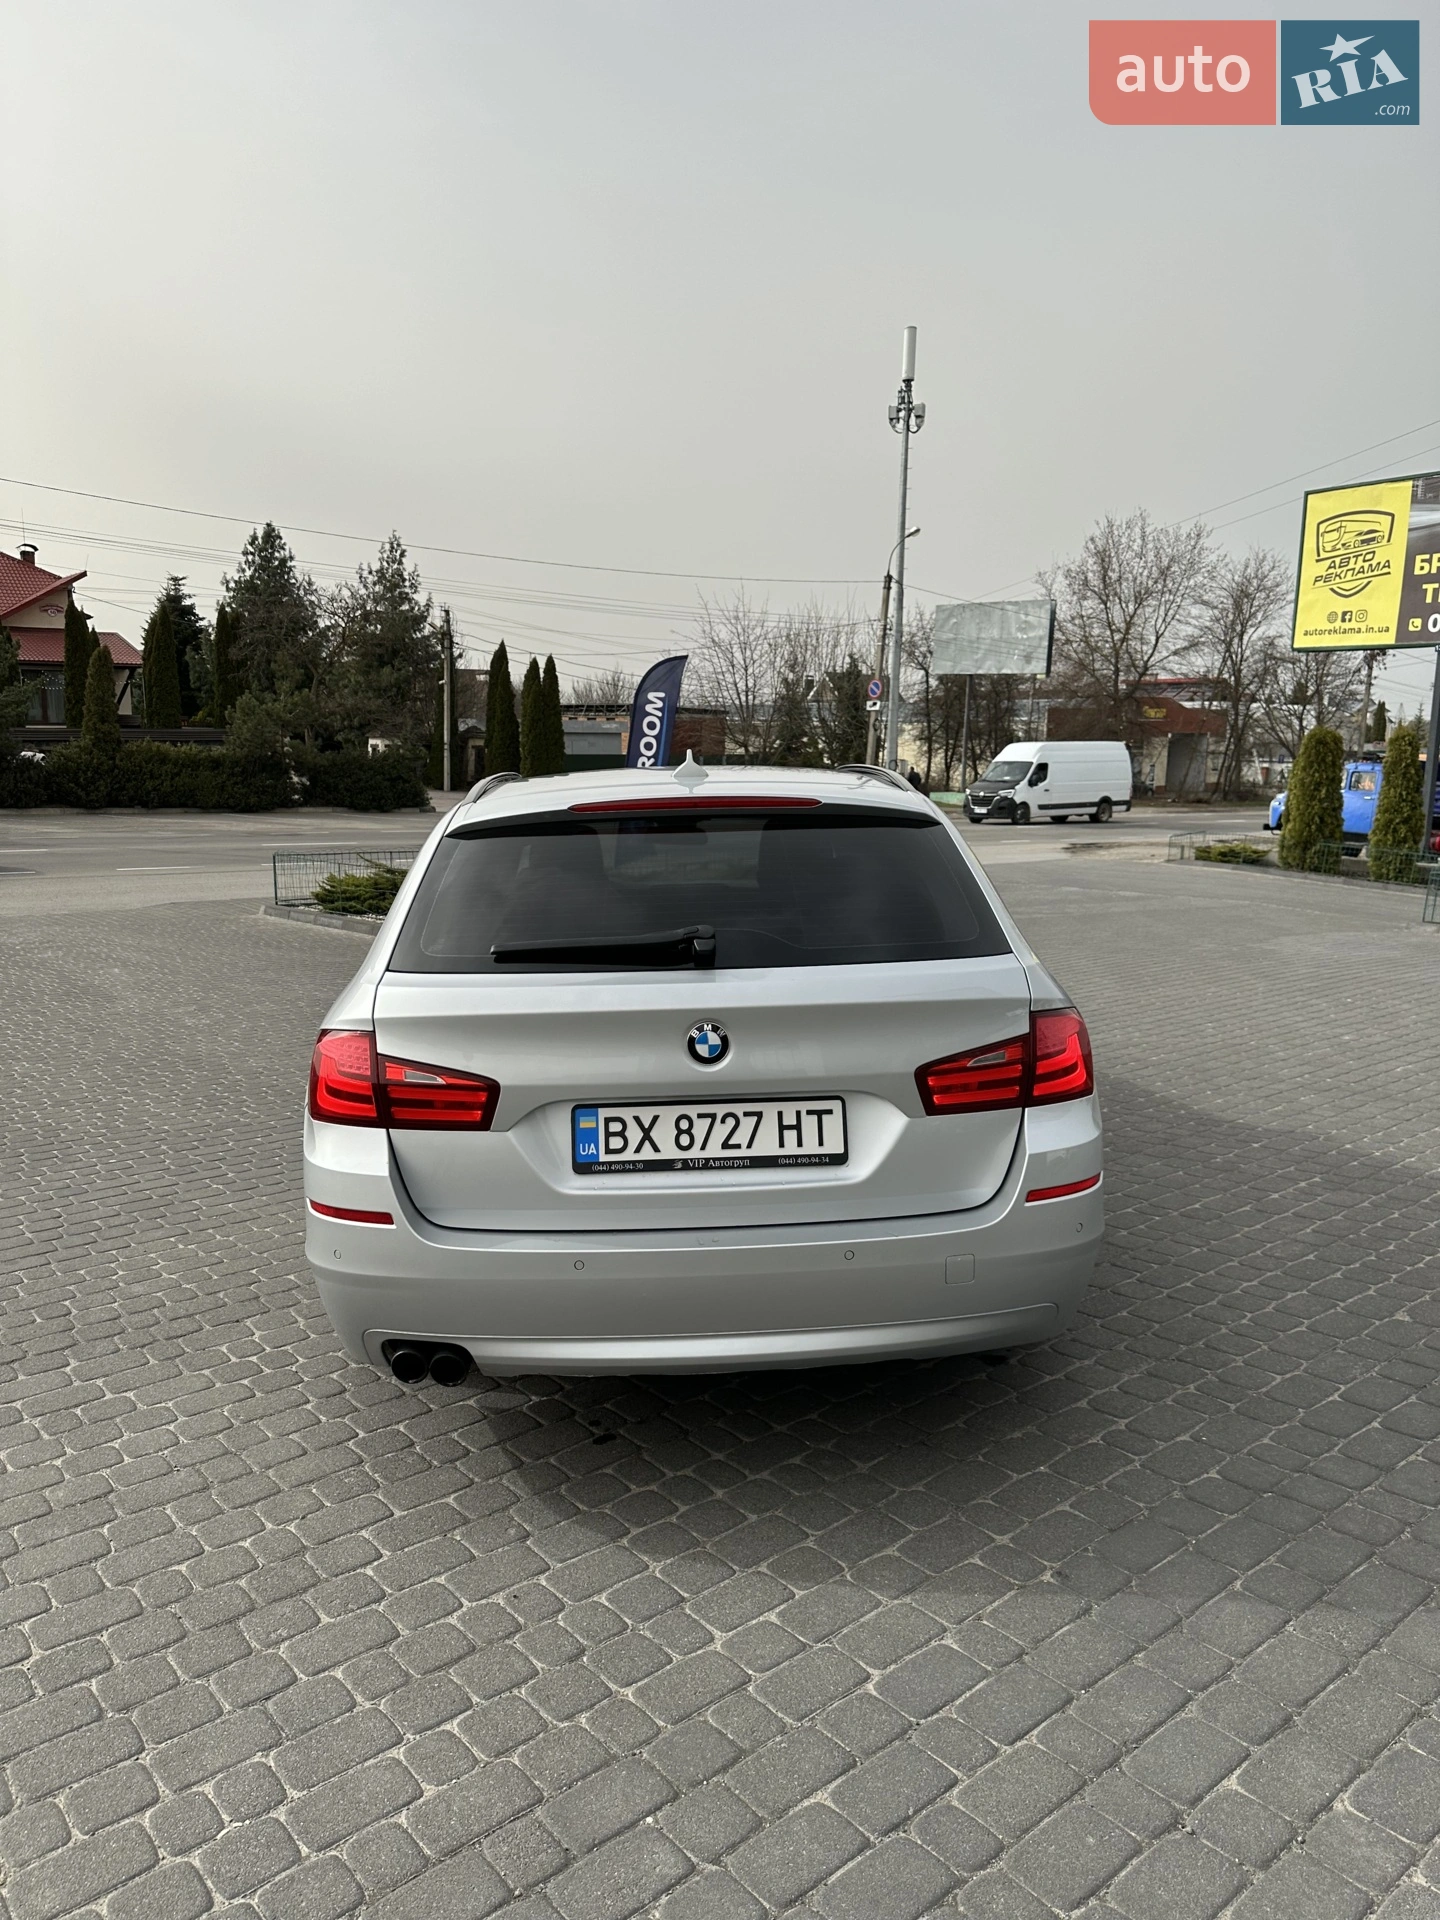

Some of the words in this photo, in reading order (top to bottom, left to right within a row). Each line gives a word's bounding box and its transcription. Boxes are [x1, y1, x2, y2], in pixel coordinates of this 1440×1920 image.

[1325, 550, 1376, 572] АВТО
[1312, 559, 1391, 587] РЕКЛАМА
[1422, 582, 1440, 604] Т
[1303, 624, 1390, 637] autoreklama.in.ua
[636, 691, 666, 768] ROOM
[604, 1114, 661, 1155] BX
[674, 1110, 763, 1152] 8727
[776, 1108, 834, 1149] HT
[579, 1143, 597, 1156] UA
[591, 1163, 610, 1172] (044)
[611, 1162, 644, 1171] 490-94-30
[687, 1159, 706, 1168] VIP
[708, 1158, 750, 1168] Автогруп
[778, 1157, 796, 1165] (044)
